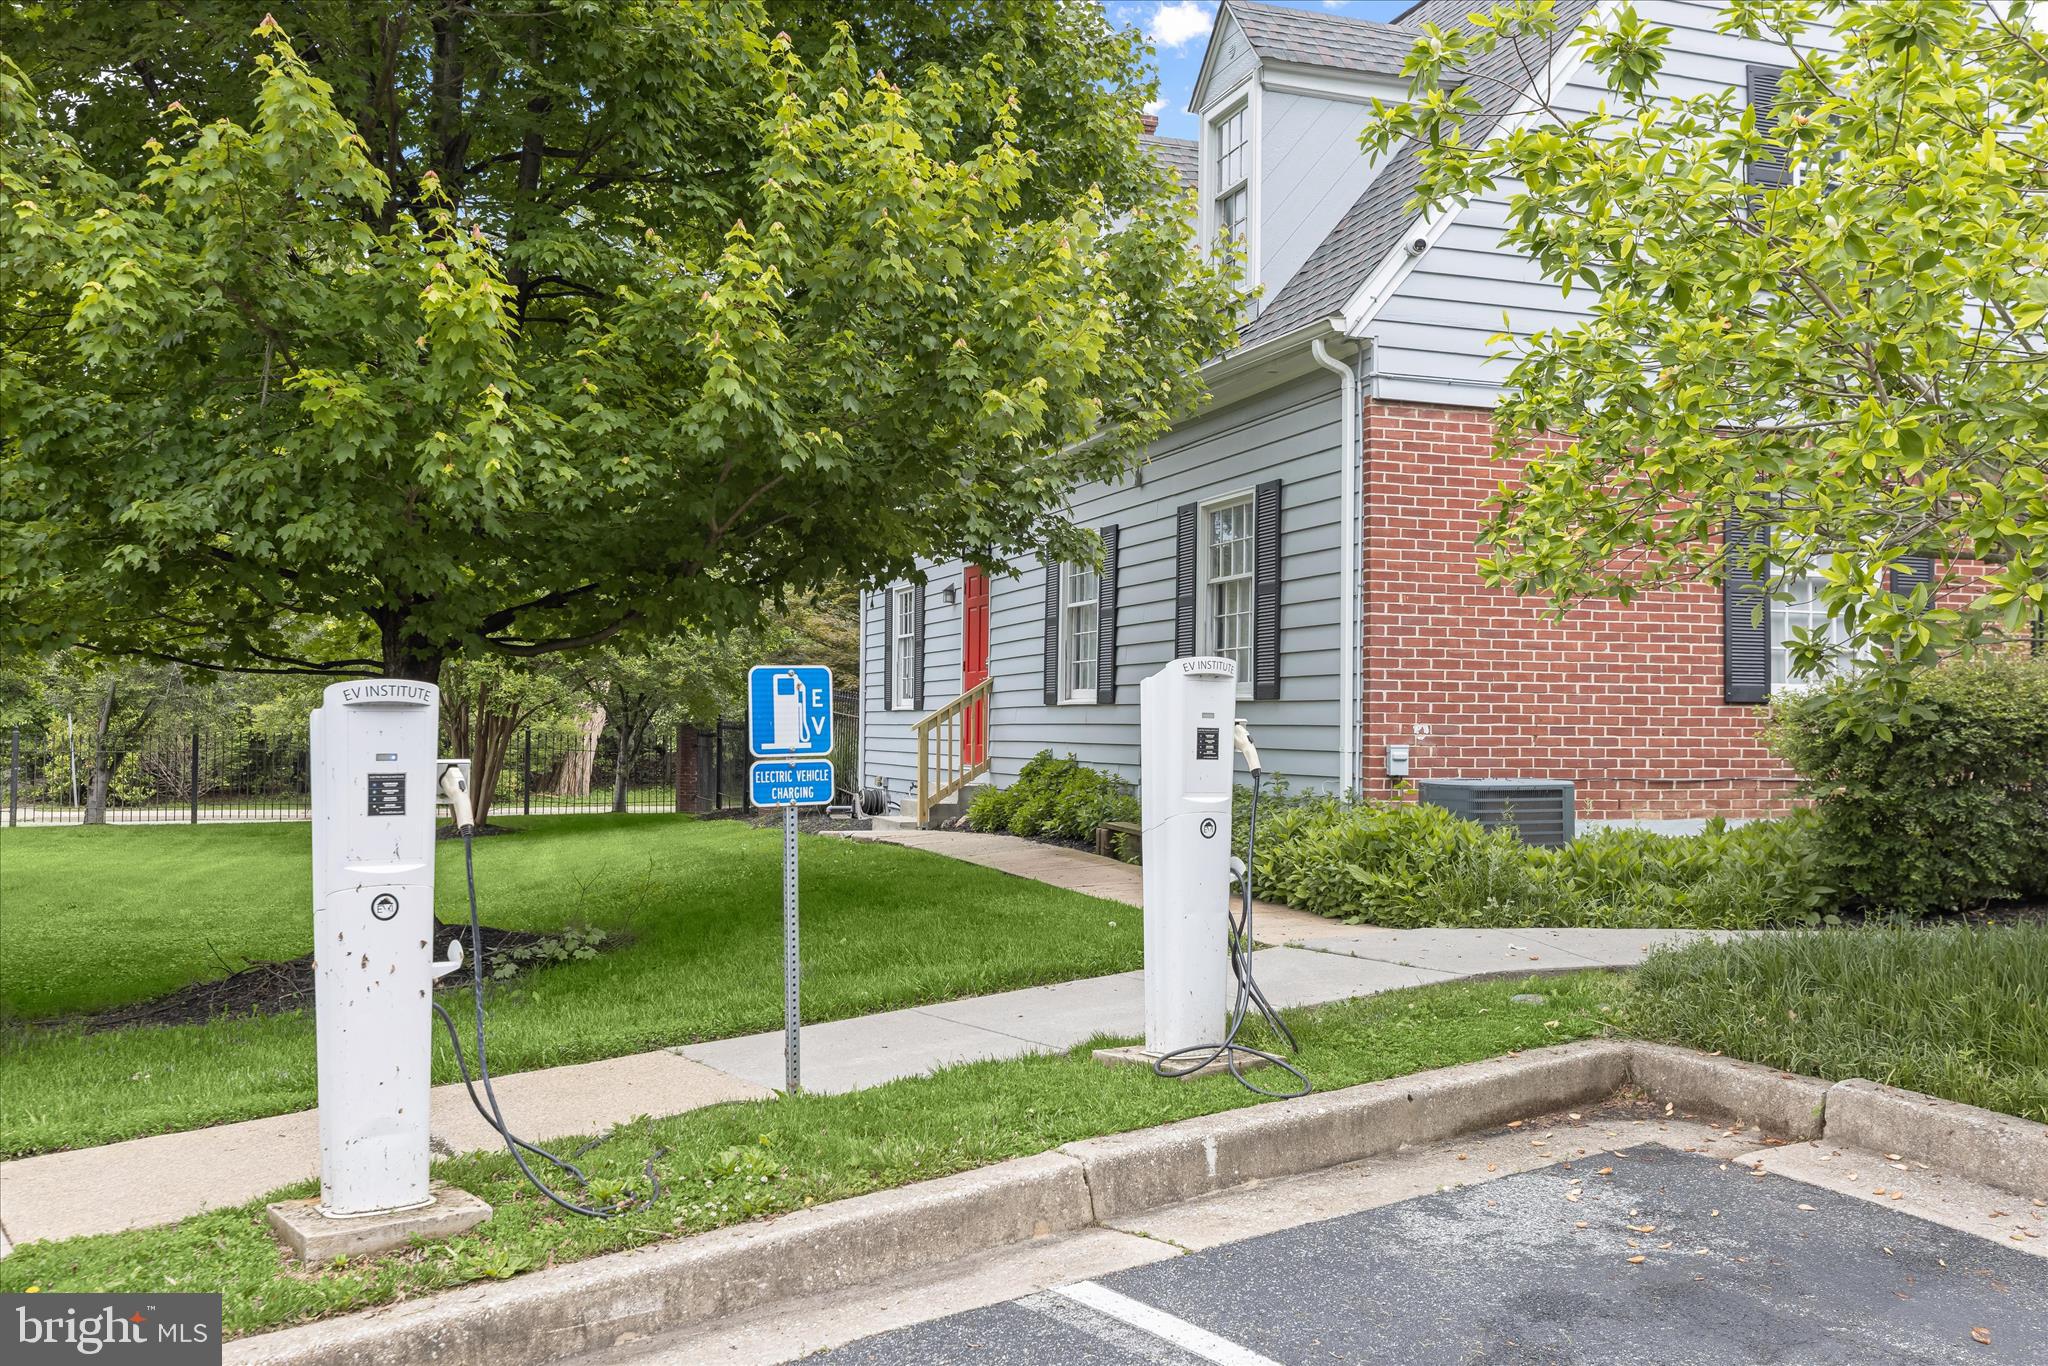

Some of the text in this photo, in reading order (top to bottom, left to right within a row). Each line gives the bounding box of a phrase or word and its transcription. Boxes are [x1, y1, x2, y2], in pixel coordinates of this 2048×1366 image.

[1183, 660, 1234, 674] EV INSTITUTE
[343, 684, 431, 702] EV INSTITUTE
[755, 769, 829, 783] ELECTRIC VEHICLE
[771, 786, 814, 800] CHARGING
